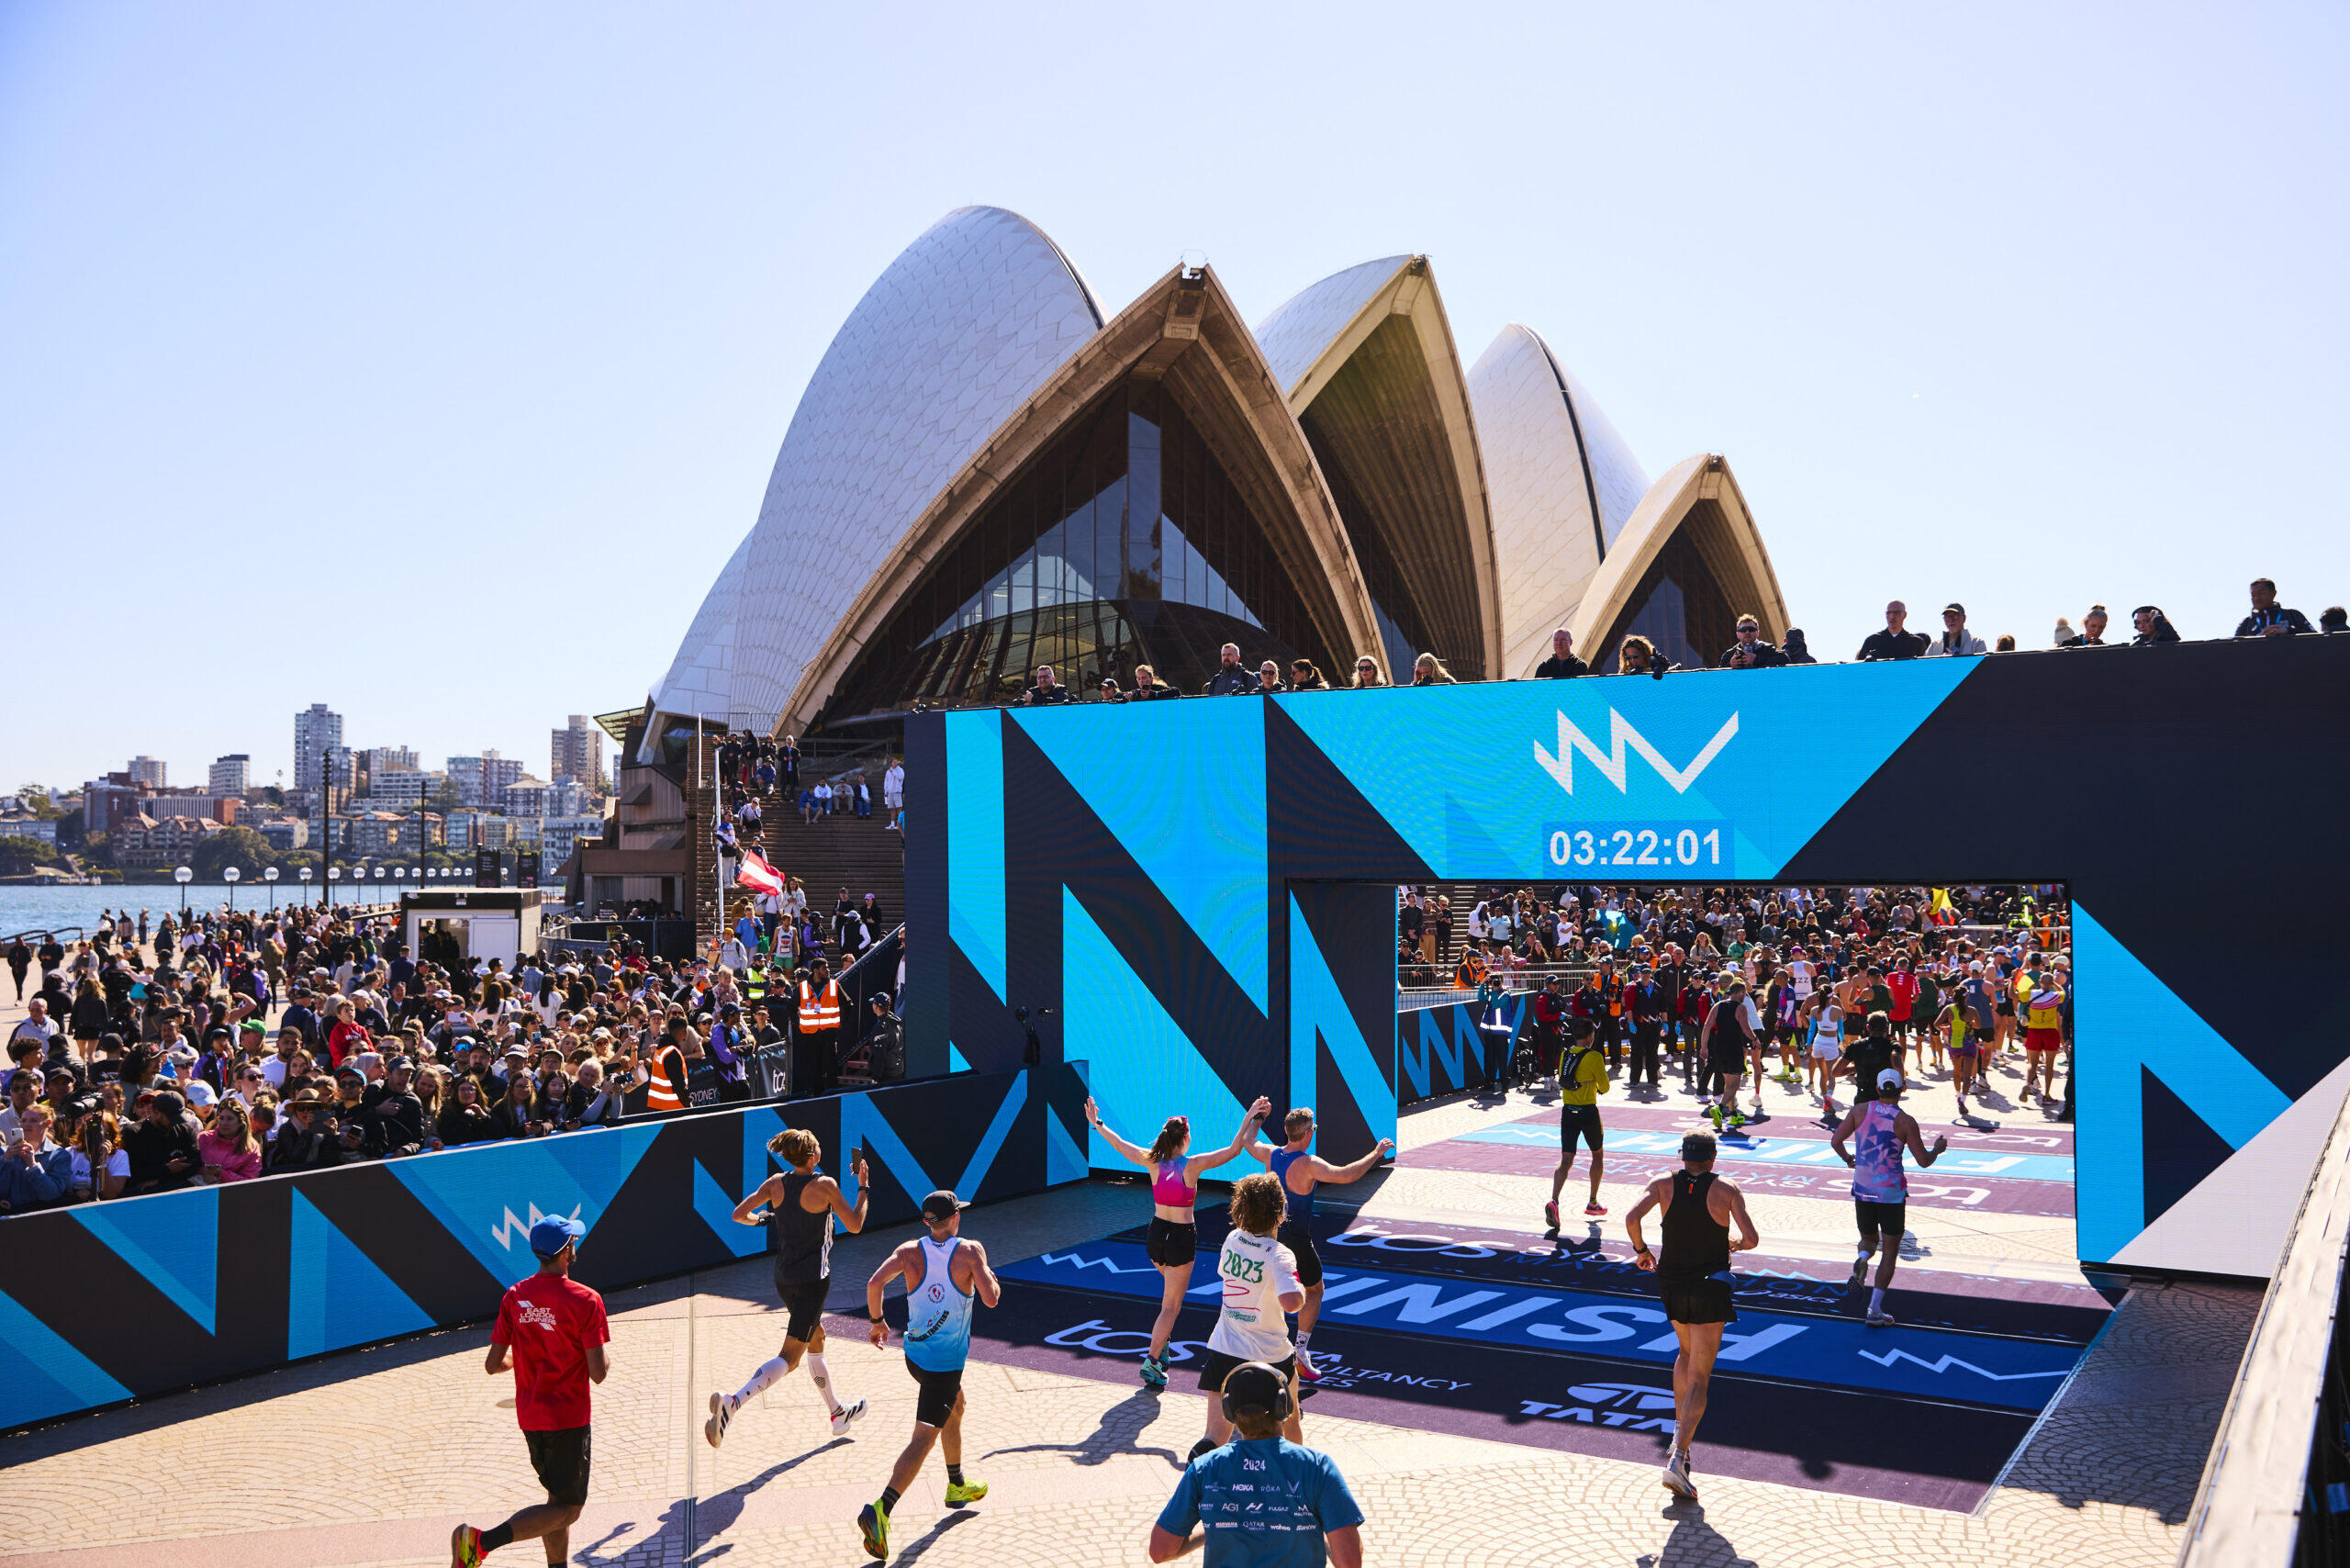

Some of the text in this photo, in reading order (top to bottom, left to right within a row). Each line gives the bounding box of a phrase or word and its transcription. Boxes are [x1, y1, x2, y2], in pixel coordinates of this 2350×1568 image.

[1550, 829, 1720, 866] 03:22:01
[689, 1088, 718, 1103] SYDNEY
[1326, 1225, 1515, 1259] tcs
[1223, 1249, 1265, 1283] 2023
[519, 1317, 556, 1326] RUNNERS
[1313, 1362, 1472, 1392] ULTANCY
[1520, 1400, 1676, 1434] TATA
[1243, 1458, 1266, 1471] 2024
[1232, 1484, 1254, 1492] HOKA
[1221, 1502, 1239, 1512] AG1
